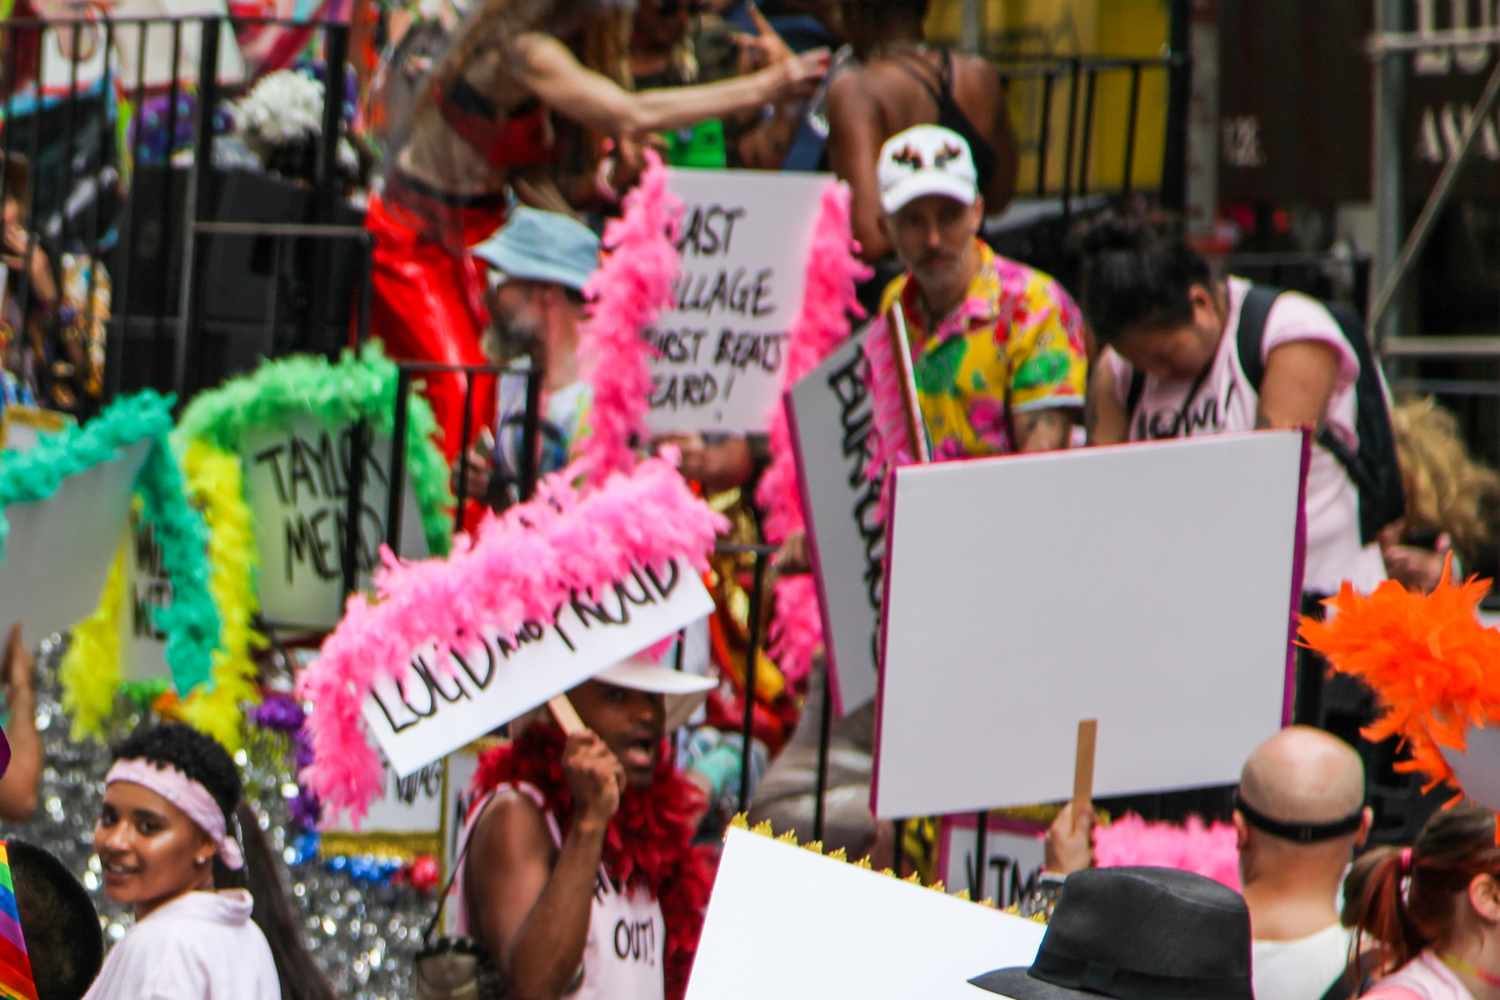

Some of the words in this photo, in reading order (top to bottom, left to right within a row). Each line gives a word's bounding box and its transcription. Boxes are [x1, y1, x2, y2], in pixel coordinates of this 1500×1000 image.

[665, 204, 745, 256] AST
[672, 268, 776, 316] ILLAGE
[647, 371, 736, 422] EARD!
[614, 916, 655, 968] OUT!
